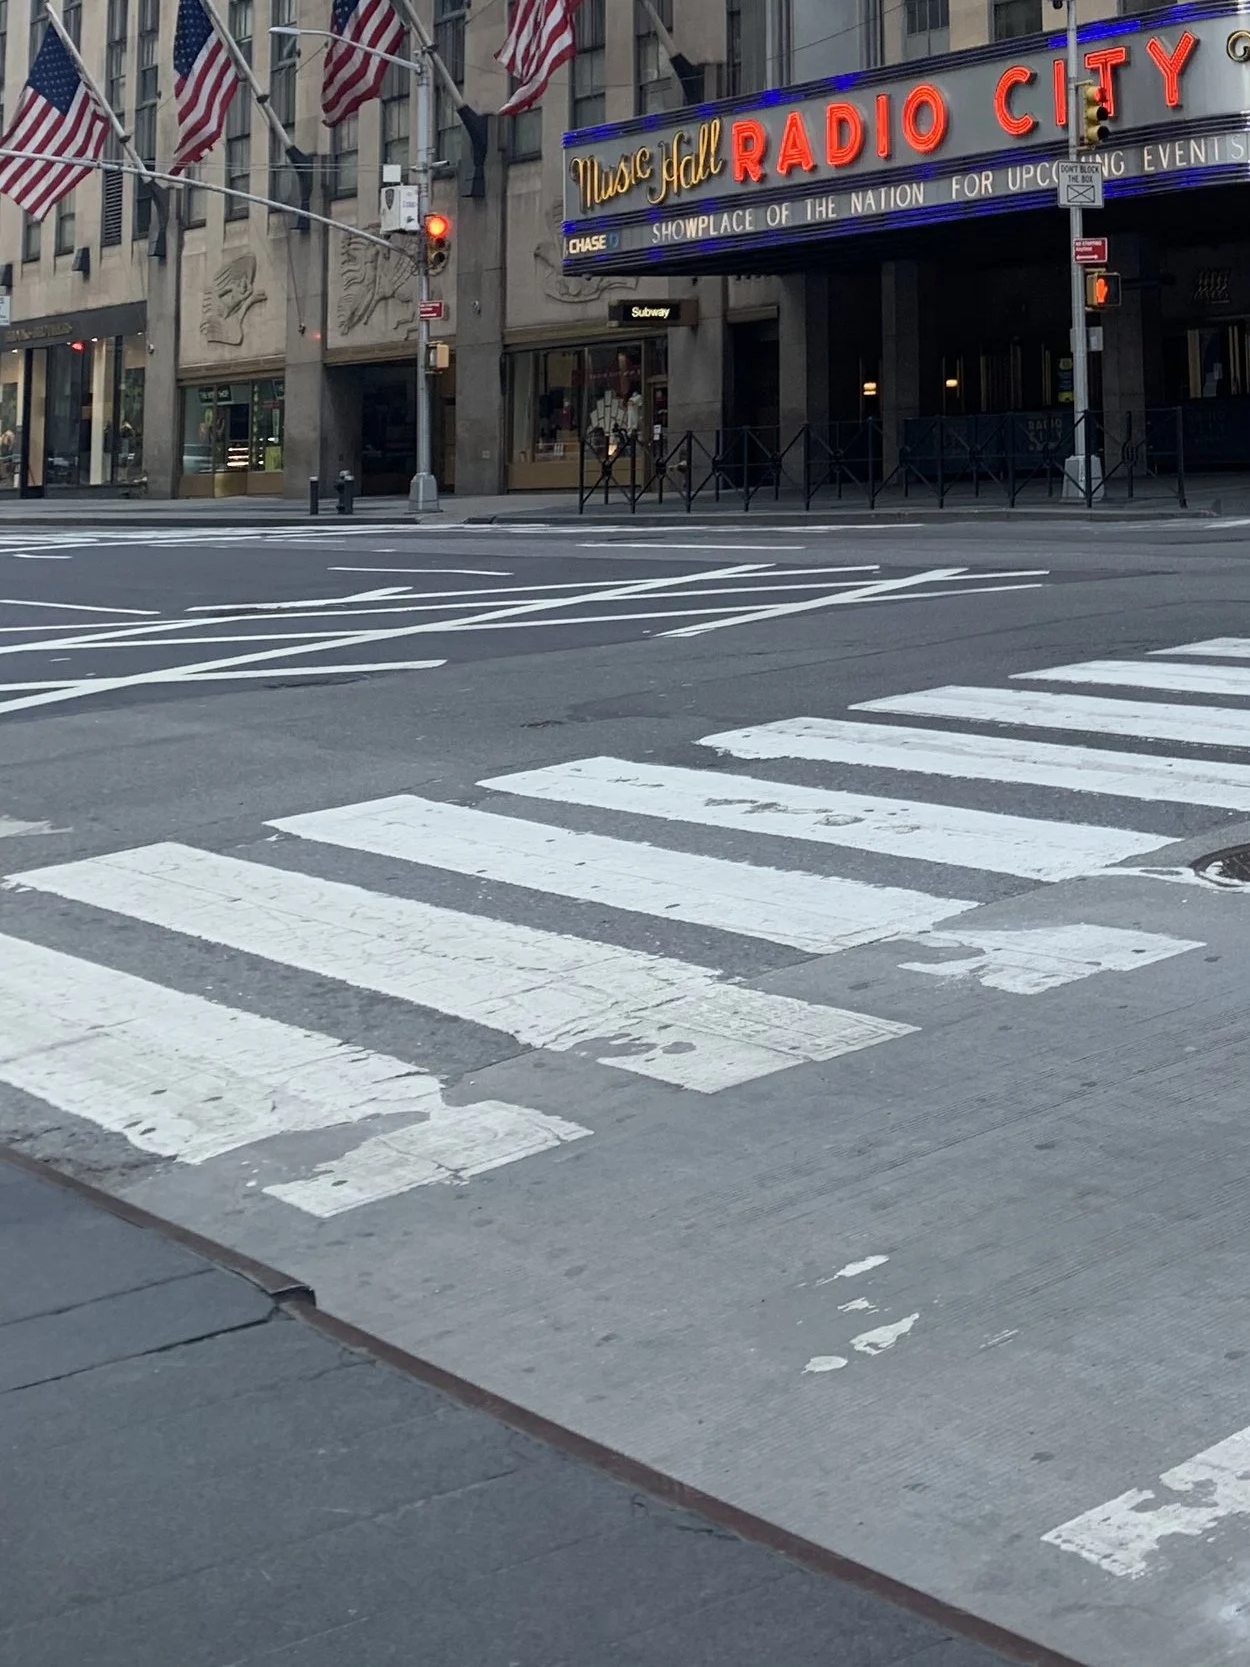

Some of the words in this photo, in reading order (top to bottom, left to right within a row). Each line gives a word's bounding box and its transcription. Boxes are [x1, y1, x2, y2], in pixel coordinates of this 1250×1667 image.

[570, 144, 655, 214] Music
[646, 116, 723, 206] Hall
[731, 82, 948, 183] RADIO
[994, 29, 1199, 137] CITY
[1080, 164, 1100, 174] BLOCK
[1068, 174, 1079, 183] THE
[1081, 175, 1093, 183] BOX
[650, 206, 755, 245] SHOWPLACE
[766, 200, 793, 228] OF
[804, 194, 837, 223] THE
[850, 180, 926, 213] NATION
[951, 168, 994, 199] FOR
[1143, 131, 1245, 172] EVENTS
[568, 233, 607, 256] CHASE
[631, 306, 671, 319] Subway
